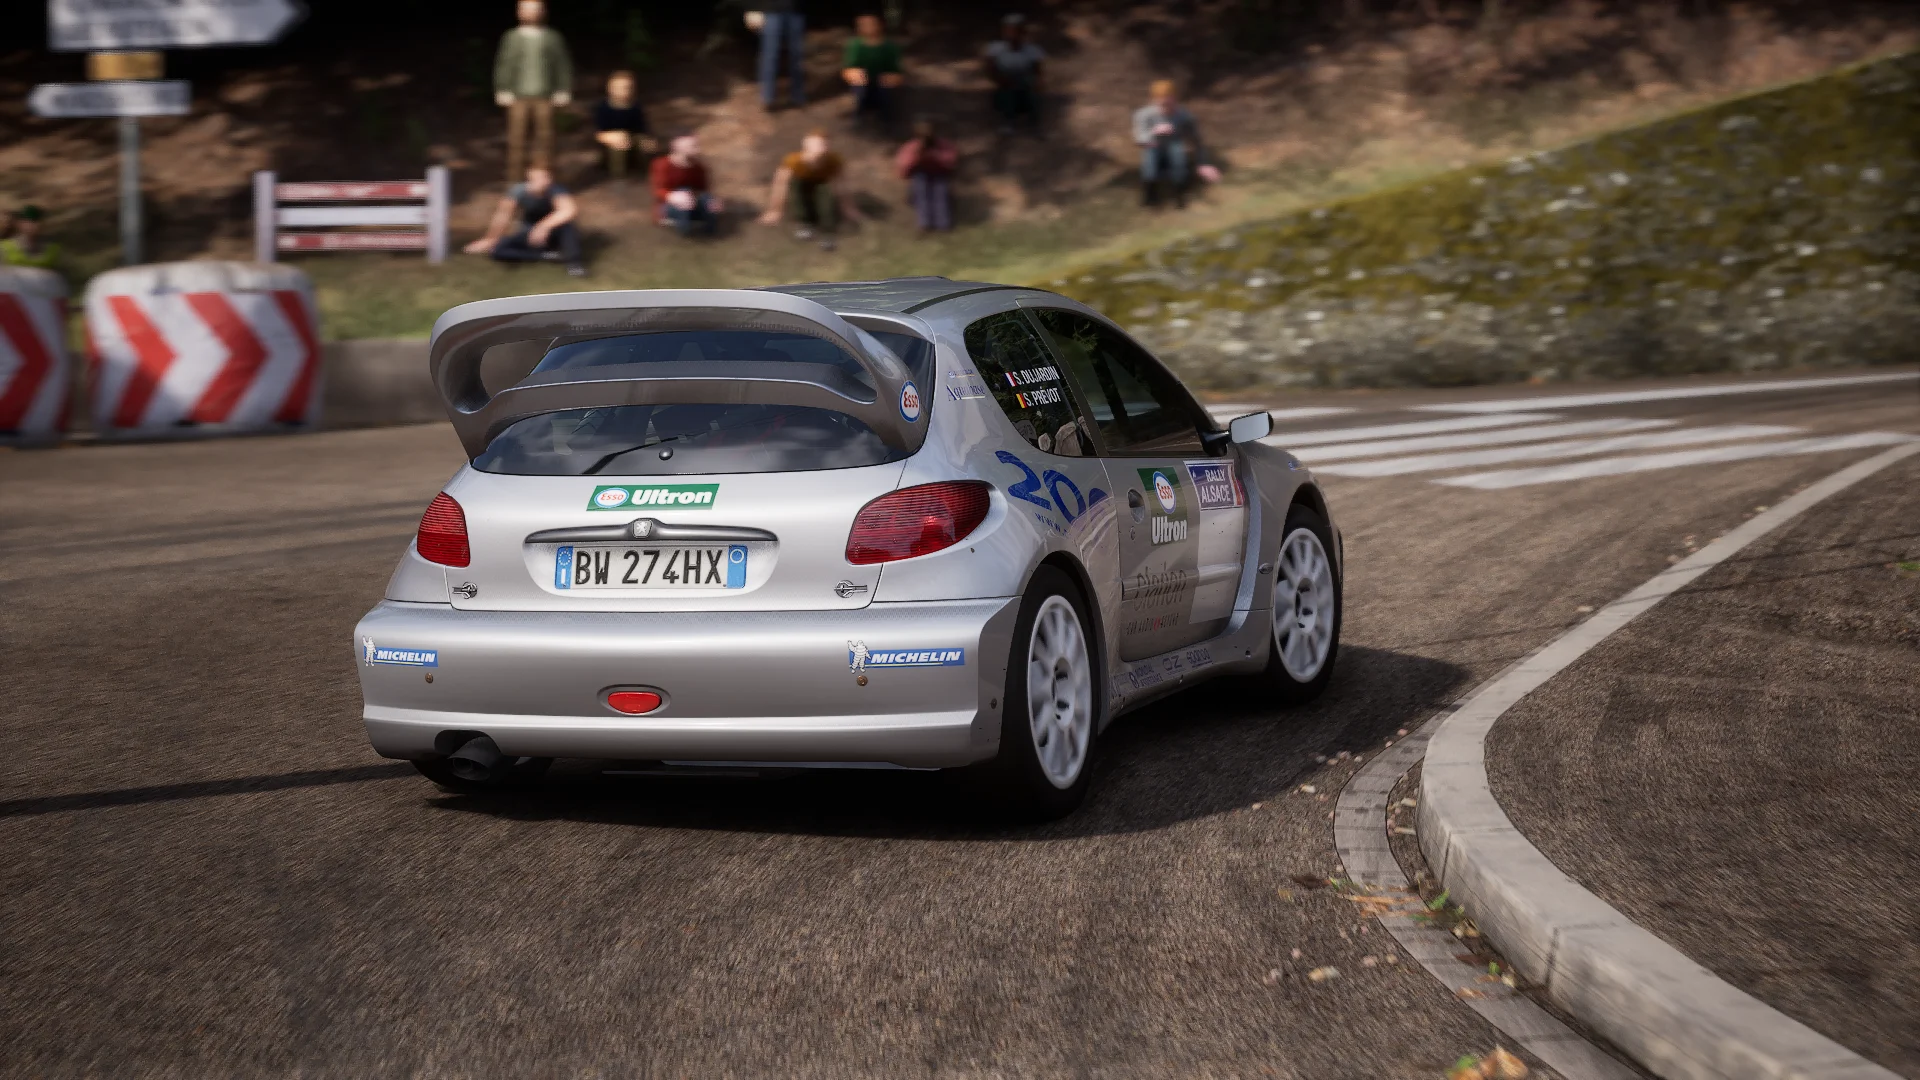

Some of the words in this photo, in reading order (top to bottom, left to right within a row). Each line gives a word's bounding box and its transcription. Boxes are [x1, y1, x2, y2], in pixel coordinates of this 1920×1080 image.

[1012, 371, 1025, 385] S.
[1020, 366, 1060, 384] DUJARDIN
[903, 391, 919, 408] Esso
[1022, 392, 1035, 407] S.
[1031, 385, 1061, 406] PRÉVOT
[1204, 469, 1226, 482] RALLY
[599, 492, 625, 501] Esso
[631, 489, 713, 505] Ultron
[1201, 484, 1231, 504] ALSACE
[1151, 516, 1188, 544] Ultron
[575, 551, 610, 585] BW
[622, 550, 722, 585] 274HX
[377, 650, 436, 663] MICHELIN
[870, 651, 962, 664] MICHELIN
